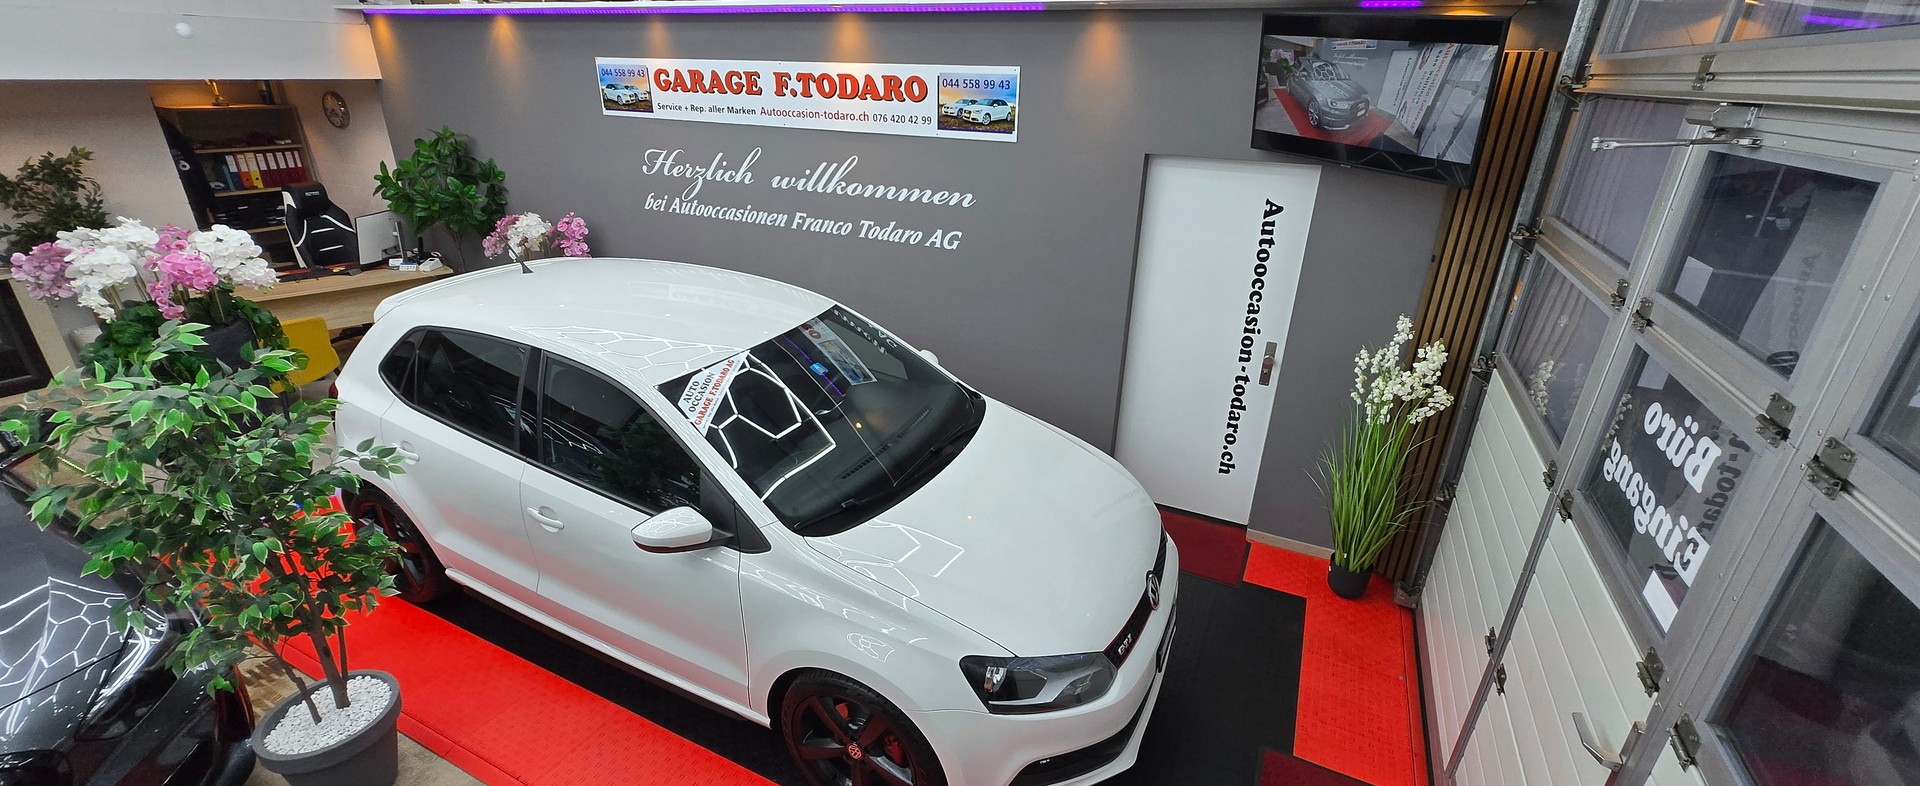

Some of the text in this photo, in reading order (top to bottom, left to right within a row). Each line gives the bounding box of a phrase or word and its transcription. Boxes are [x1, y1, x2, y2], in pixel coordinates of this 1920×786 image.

[601, 68, 645, 78] 044 558 99 43
[653, 68, 928, 103] GARAGE F.TODARO
[942, 78, 1011, 90] 044 558 99 43
[657, 102, 683, 112] Service
[690, 104, 707, 115] Rep.
[708, 105, 725, 114] aller
[727, 106, 757, 116] Marken
[760, 106, 870, 122] Autooccasion-todaro.ch
[872, 113, 888, 123] 076
[890, 114, 906, 124] 420
[908, 115, 919, 124] 42
[921, 115, 932, 125] 99
[642, 147, 977, 209] Herzlich willkommen
[644, 192, 962, 251] bei Autooccasionen Franco Todaro AG
[1218, 198, 1284, 475] Autooccasion-todaro.ch
[683, 381, 700, 404] AUTO
[688, 371, 716, 412] OCCASION
[694, 397, 713, 426] GARAGE
